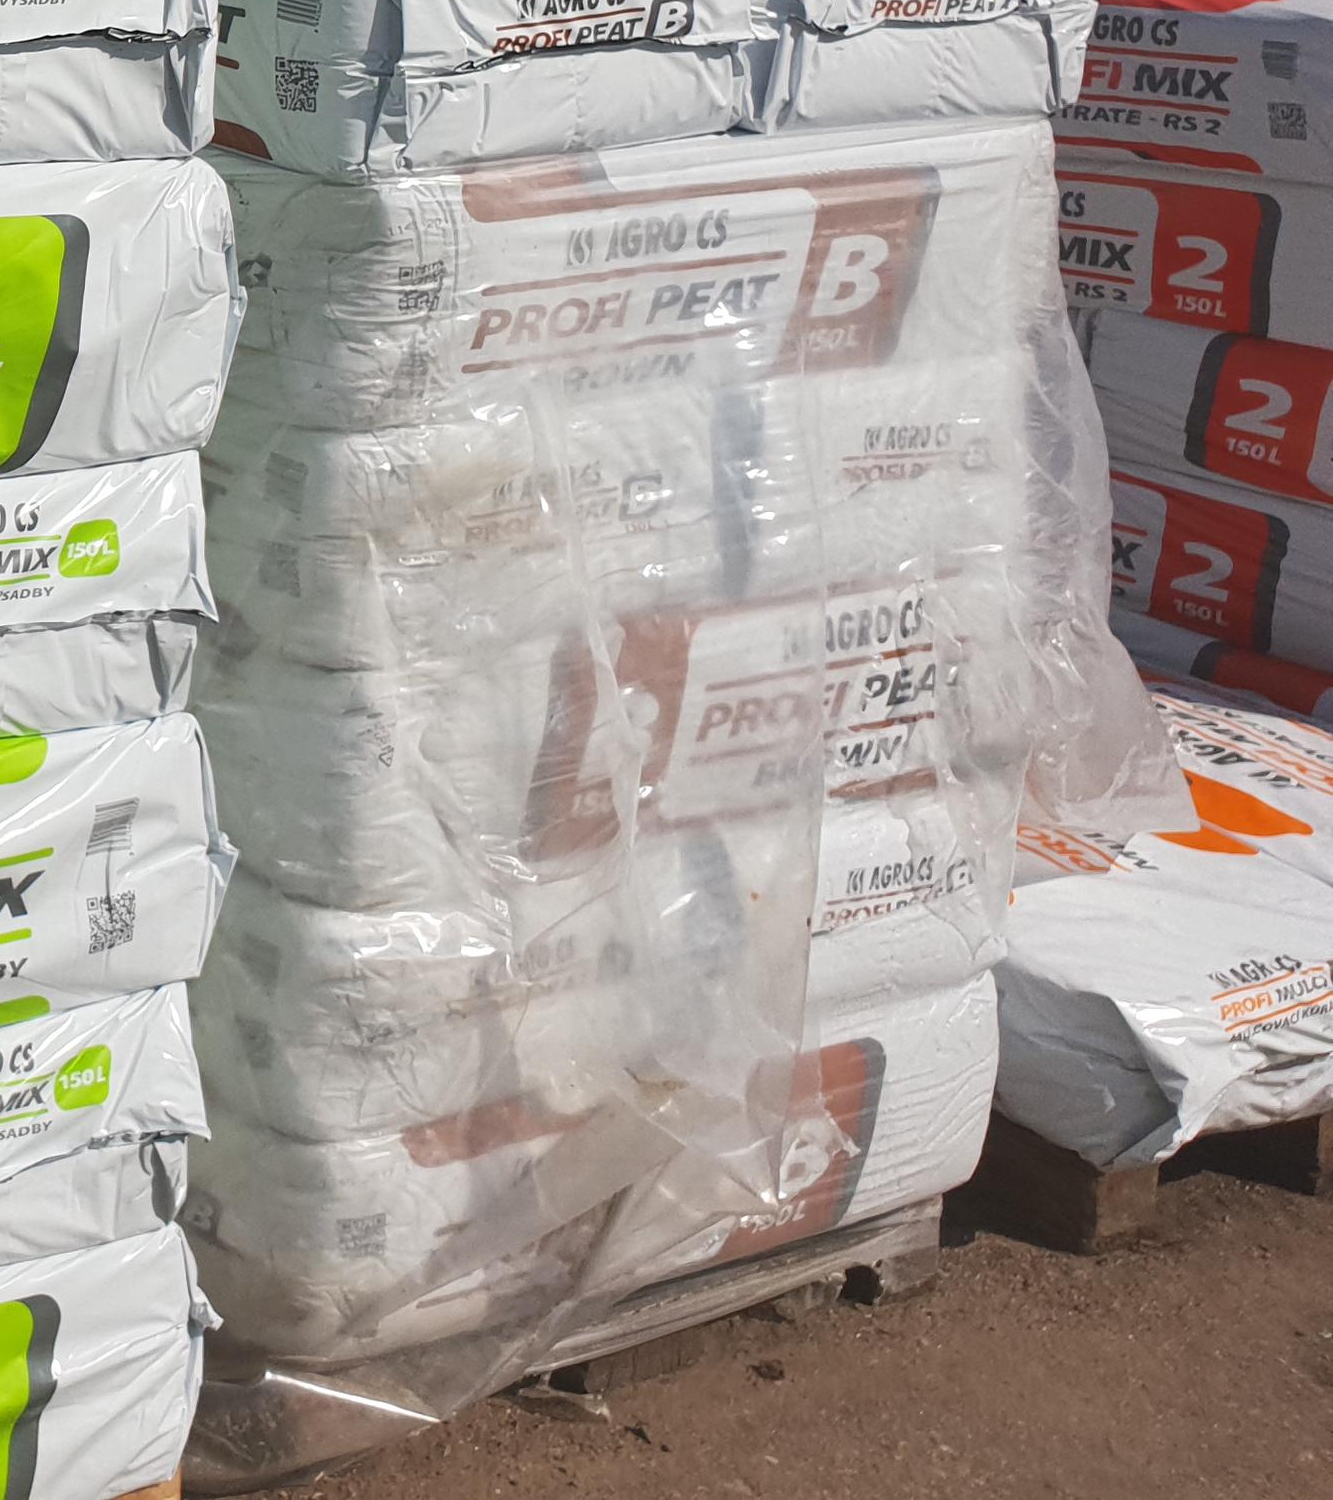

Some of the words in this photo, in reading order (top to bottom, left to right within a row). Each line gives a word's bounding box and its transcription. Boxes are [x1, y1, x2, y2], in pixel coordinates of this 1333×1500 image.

[653, 1, 687, 36] B
[871, 0, 942, 18] PROFI
[575, 18, 643, 44] PEAT
[1091, 15, 1143, 44] GRO
[1151, 17, 1178, 46] CS
[1133, 64, 1232, 102] MIX
[1049, 103, 1141, 126] TRATE
[1164, 114, 1197, 131] RS
[1202, 119, 1221, 136] 2
[1061, 192, 1086, 217] CS
[605, 214, 687, 261] AGRO
[696, 209, 729, 250] CS
[1060, 235, 1133, 272] MIX
[1167, 236, 1228, 293] 2
[810, 235, 888, 318] B
[1075, 284, 1105, 299] RS
[1113, 288, 1127, 302] 2
[470, 291, 630, 350] PROFI
[645, 273, 780, 325] PEAT
[1225, 380, 1292, 439] 2
[13, 503, 40, 533] CS
[1170, 541, 1233, 602] 2
[869, 860, 913, 890] AGRO
[917, 856, 934, 881] CS
[1220, 992, 1272, 1021] PROFI
[9, 1043, 34, 1074] CS
